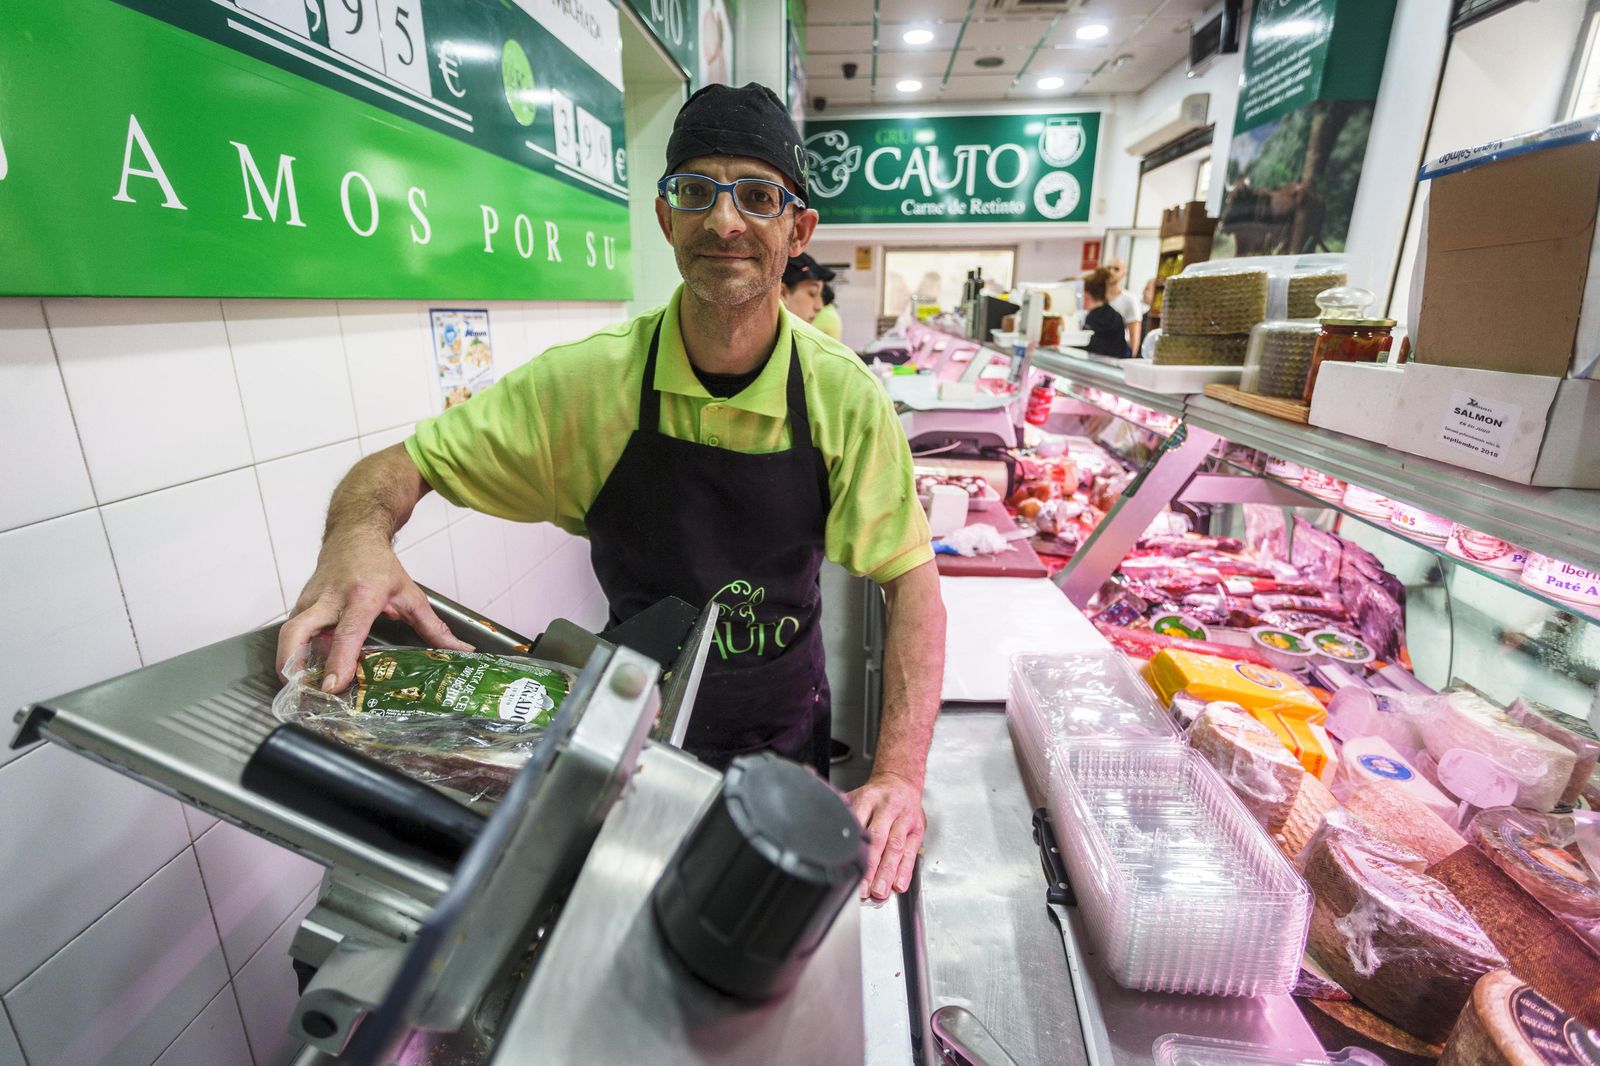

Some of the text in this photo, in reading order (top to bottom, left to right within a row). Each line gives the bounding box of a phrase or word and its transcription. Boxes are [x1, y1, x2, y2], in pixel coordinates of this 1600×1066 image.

[875, 128, 936, 146] GRU
[864, 143, 1030, 196] CAUTO
[0, 114, 616, 270] AMOS POR SU
[900, 198, 945, 216] Carne
[947, 197, 967, 216] de
[970, 197, 1026, 215] Retinto
[1453, 406, 1503, 428] SALMON
[1442, 434, 1499, 458] septiembre 2018
[1545, 574, 1582, 594] Paté
[711, 616, 800, 660] AUTO
[461, 682, 477, 698] DE
